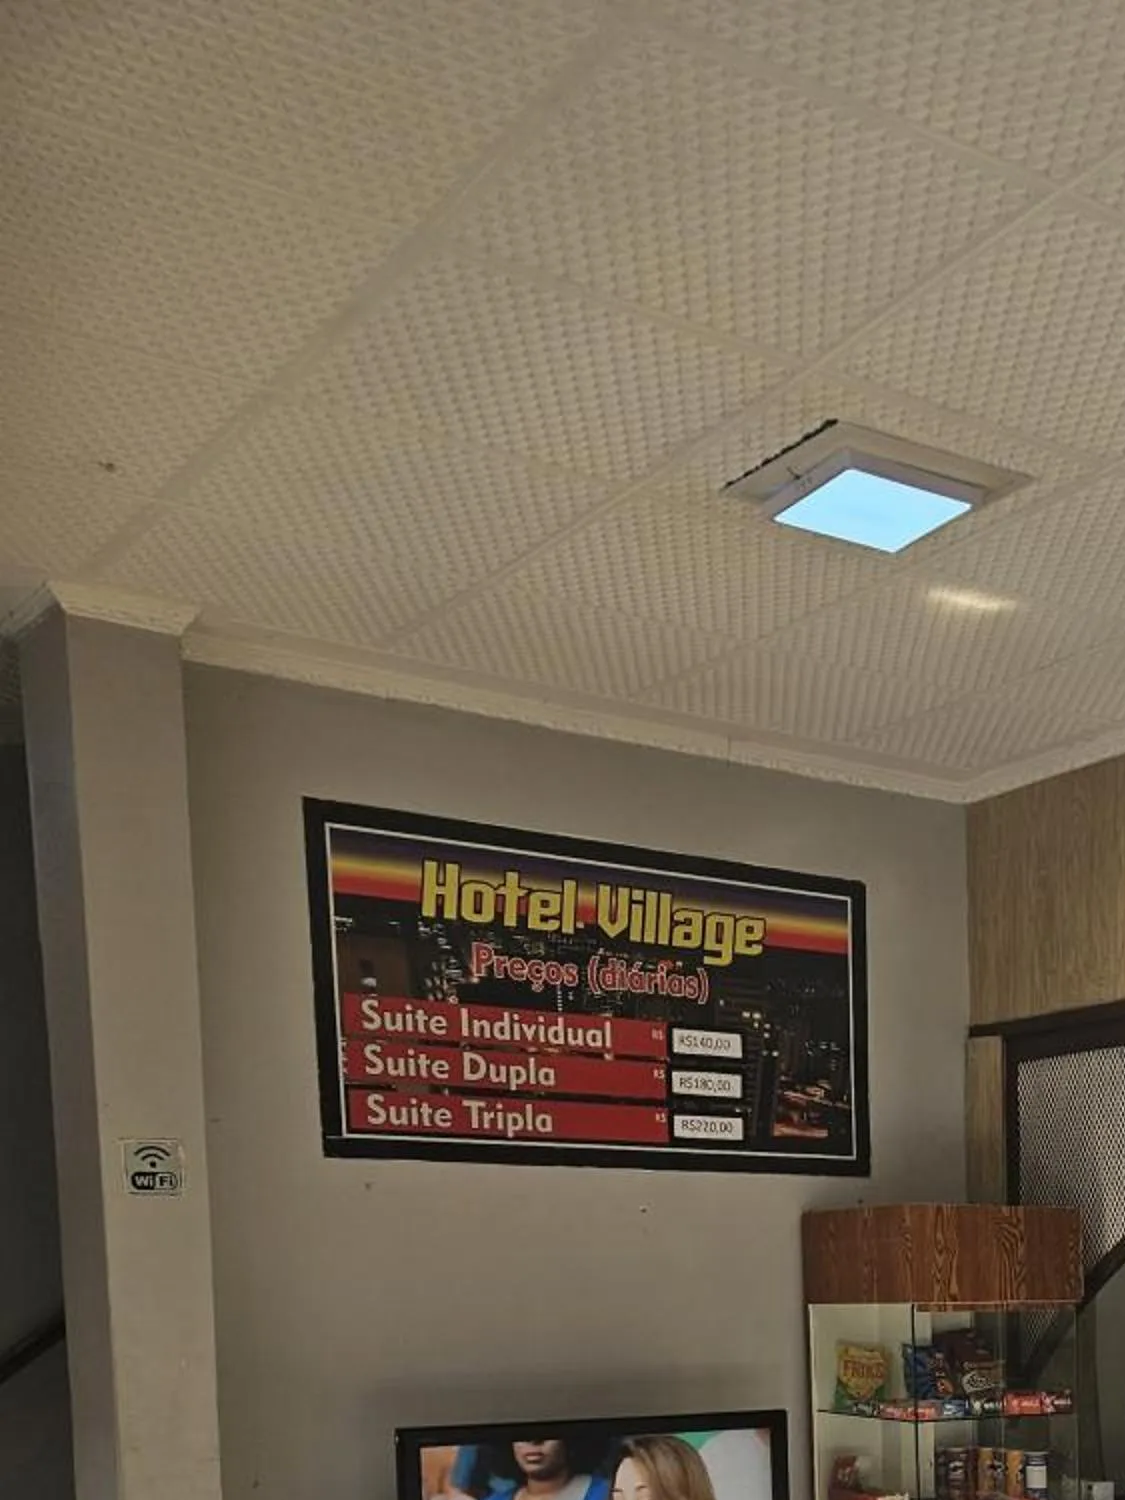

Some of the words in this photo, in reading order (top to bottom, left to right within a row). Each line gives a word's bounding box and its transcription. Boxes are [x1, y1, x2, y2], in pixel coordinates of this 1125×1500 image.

[421, 858, 577, 935] Hotel
[597, 883, 765, 966] Village
[471, 940, 578, 992] Preços
[587, 955, 709, 1004] (diárias)
[361, 999, 448, 1035] Suite
[460, 1008, 612, 1048] Individual
[364, 1043, 449, 1079] Suite
[463, 1052, 556, 1091] Dupla
[367, 1093, 452, 1127] Suite
[462, 1100, 553, 1138] Tripla
